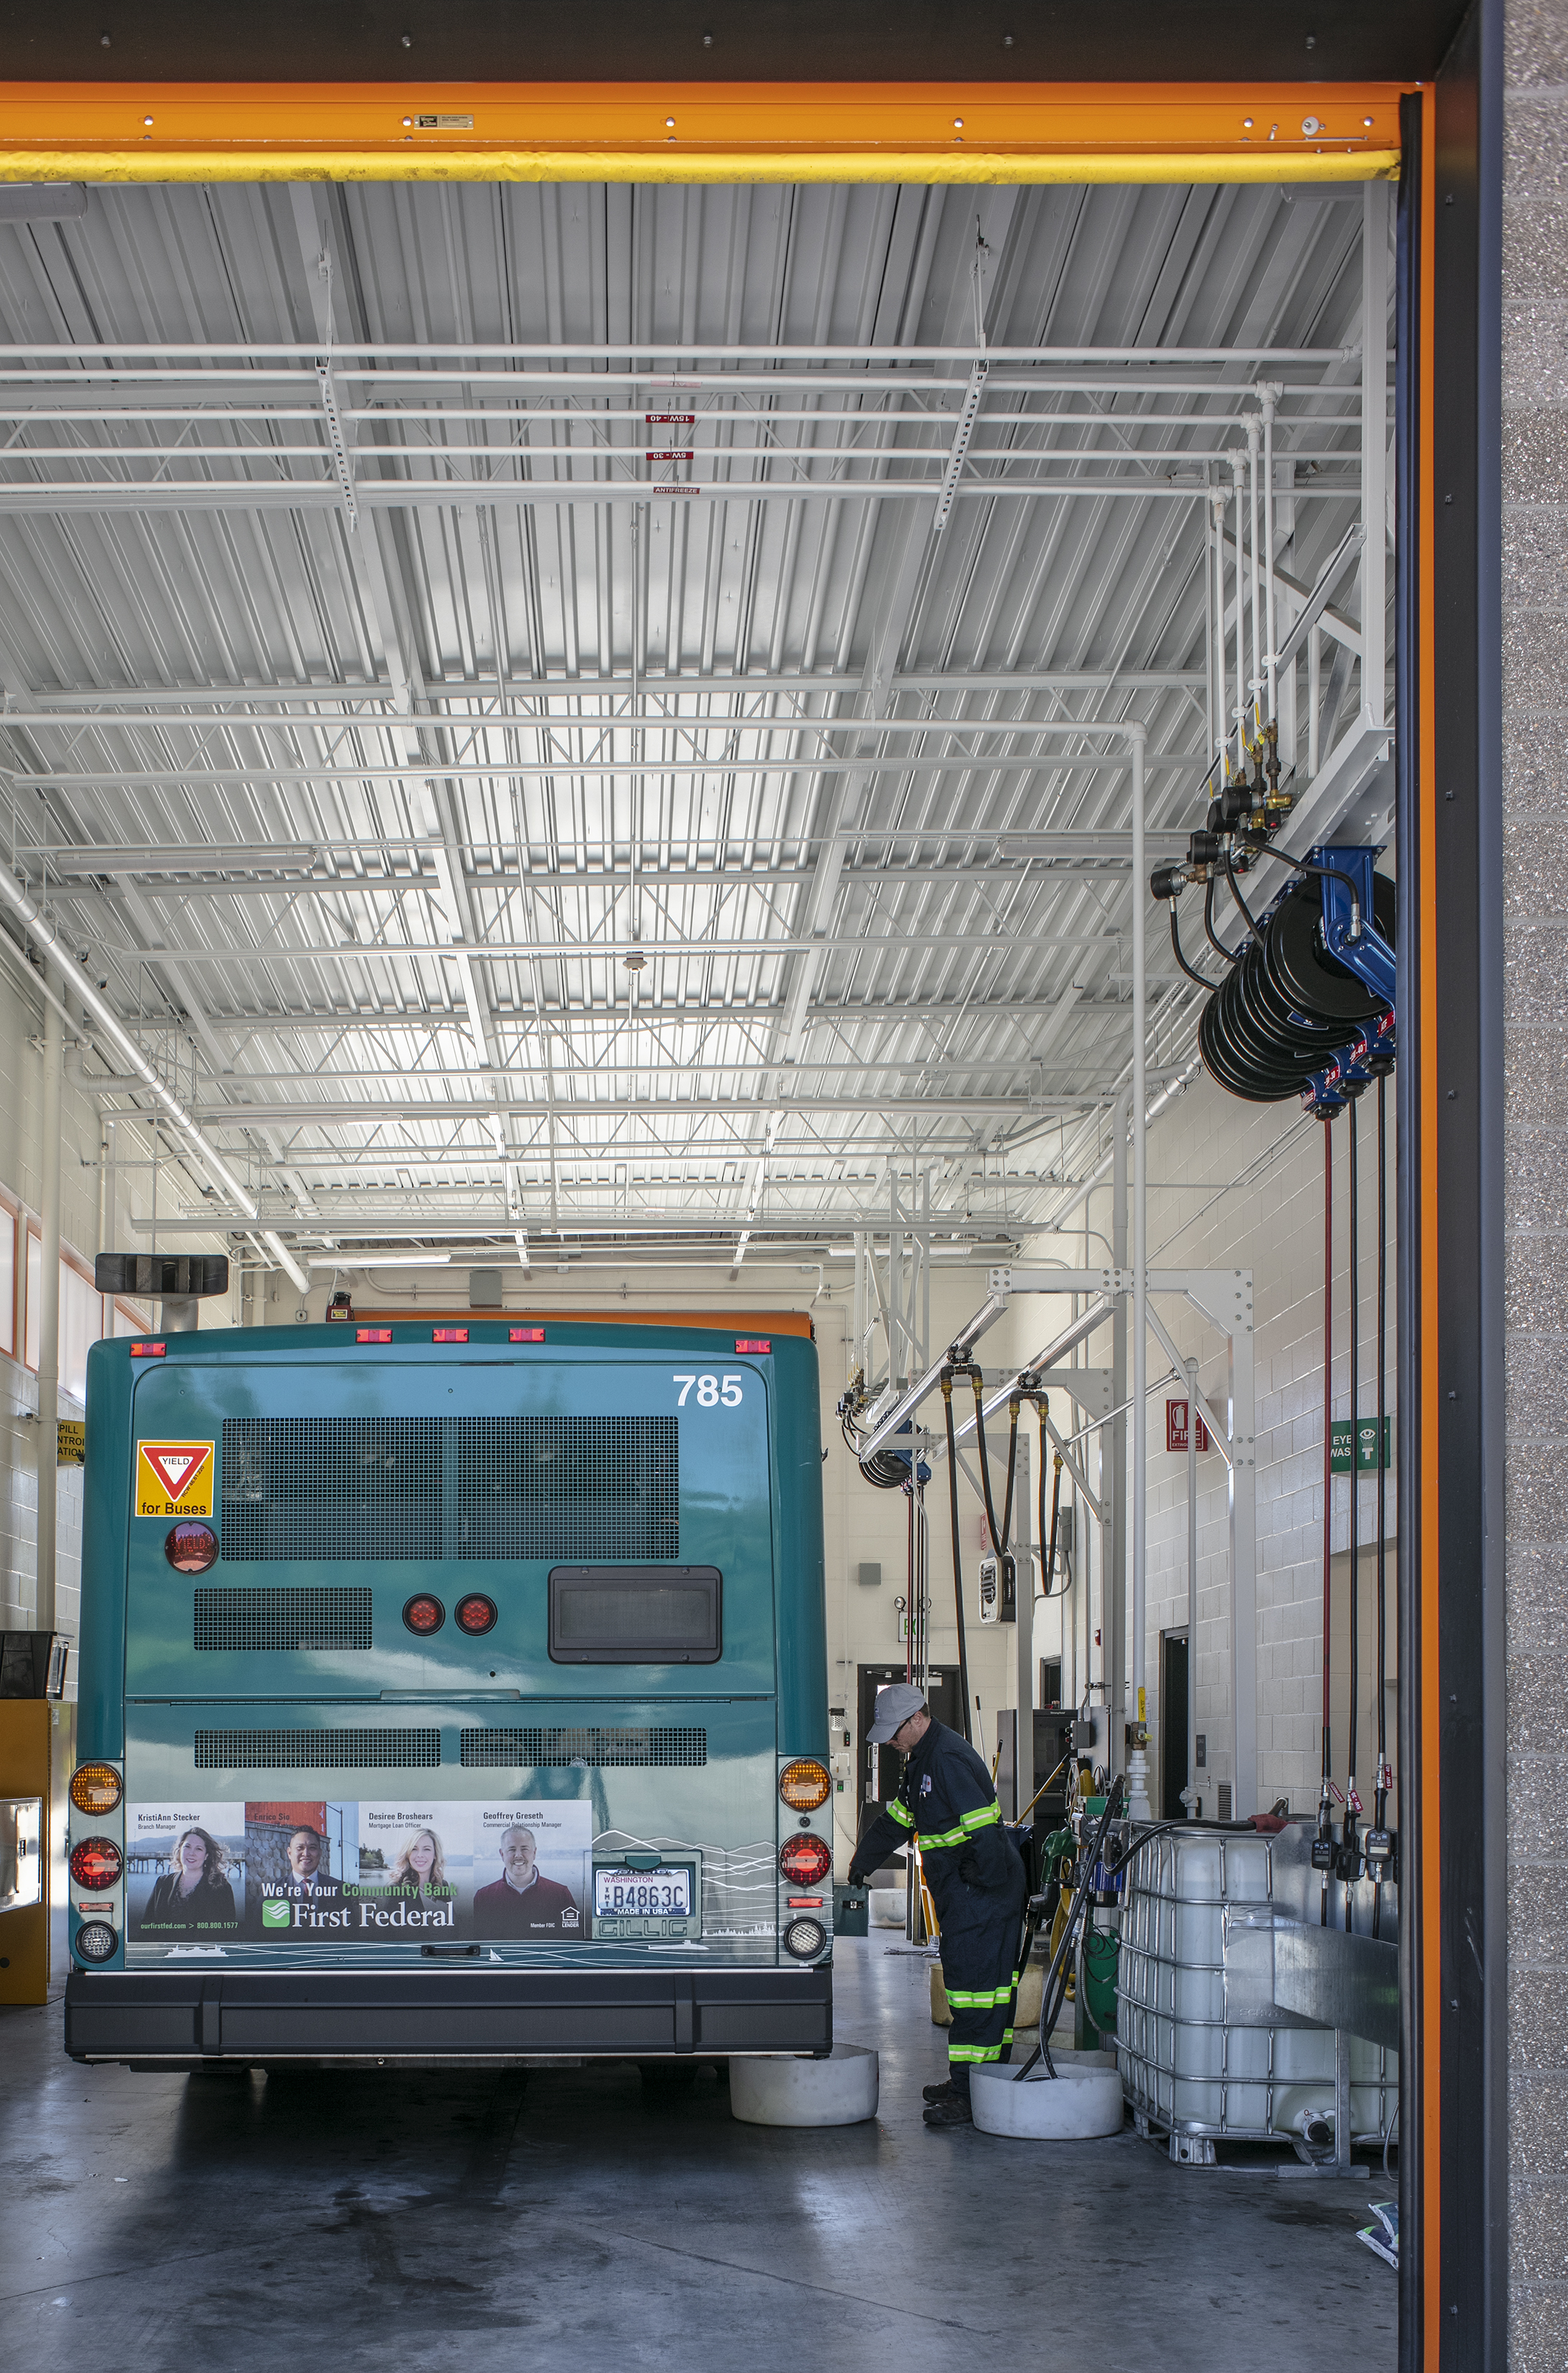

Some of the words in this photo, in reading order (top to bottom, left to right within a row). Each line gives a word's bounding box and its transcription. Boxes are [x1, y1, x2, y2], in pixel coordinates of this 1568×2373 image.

[673, 1374, 743, 1407] 785
[181, 1486, 191, 1498] RCW
[190, 1466, 205, 1487] 46.61.220
[142, 1502, 160, 1514] for
[165, 1503, 207, 1514] Buses
[177, 1538, 206, 1549] YIELD
[262, 1883, 301, 1897] We're
[306, 1883, 338, 1897] Your
[342, 1883, 418, 1899] Community
[423, 1883, 457, 1897] Bank
[614, 1886, 684, 1907] B4863C
[292, 1903, 351, 1927] First
[359, 1901, 454, 1927] Federal
[599, 1919, 687, 1937] GILLIG
